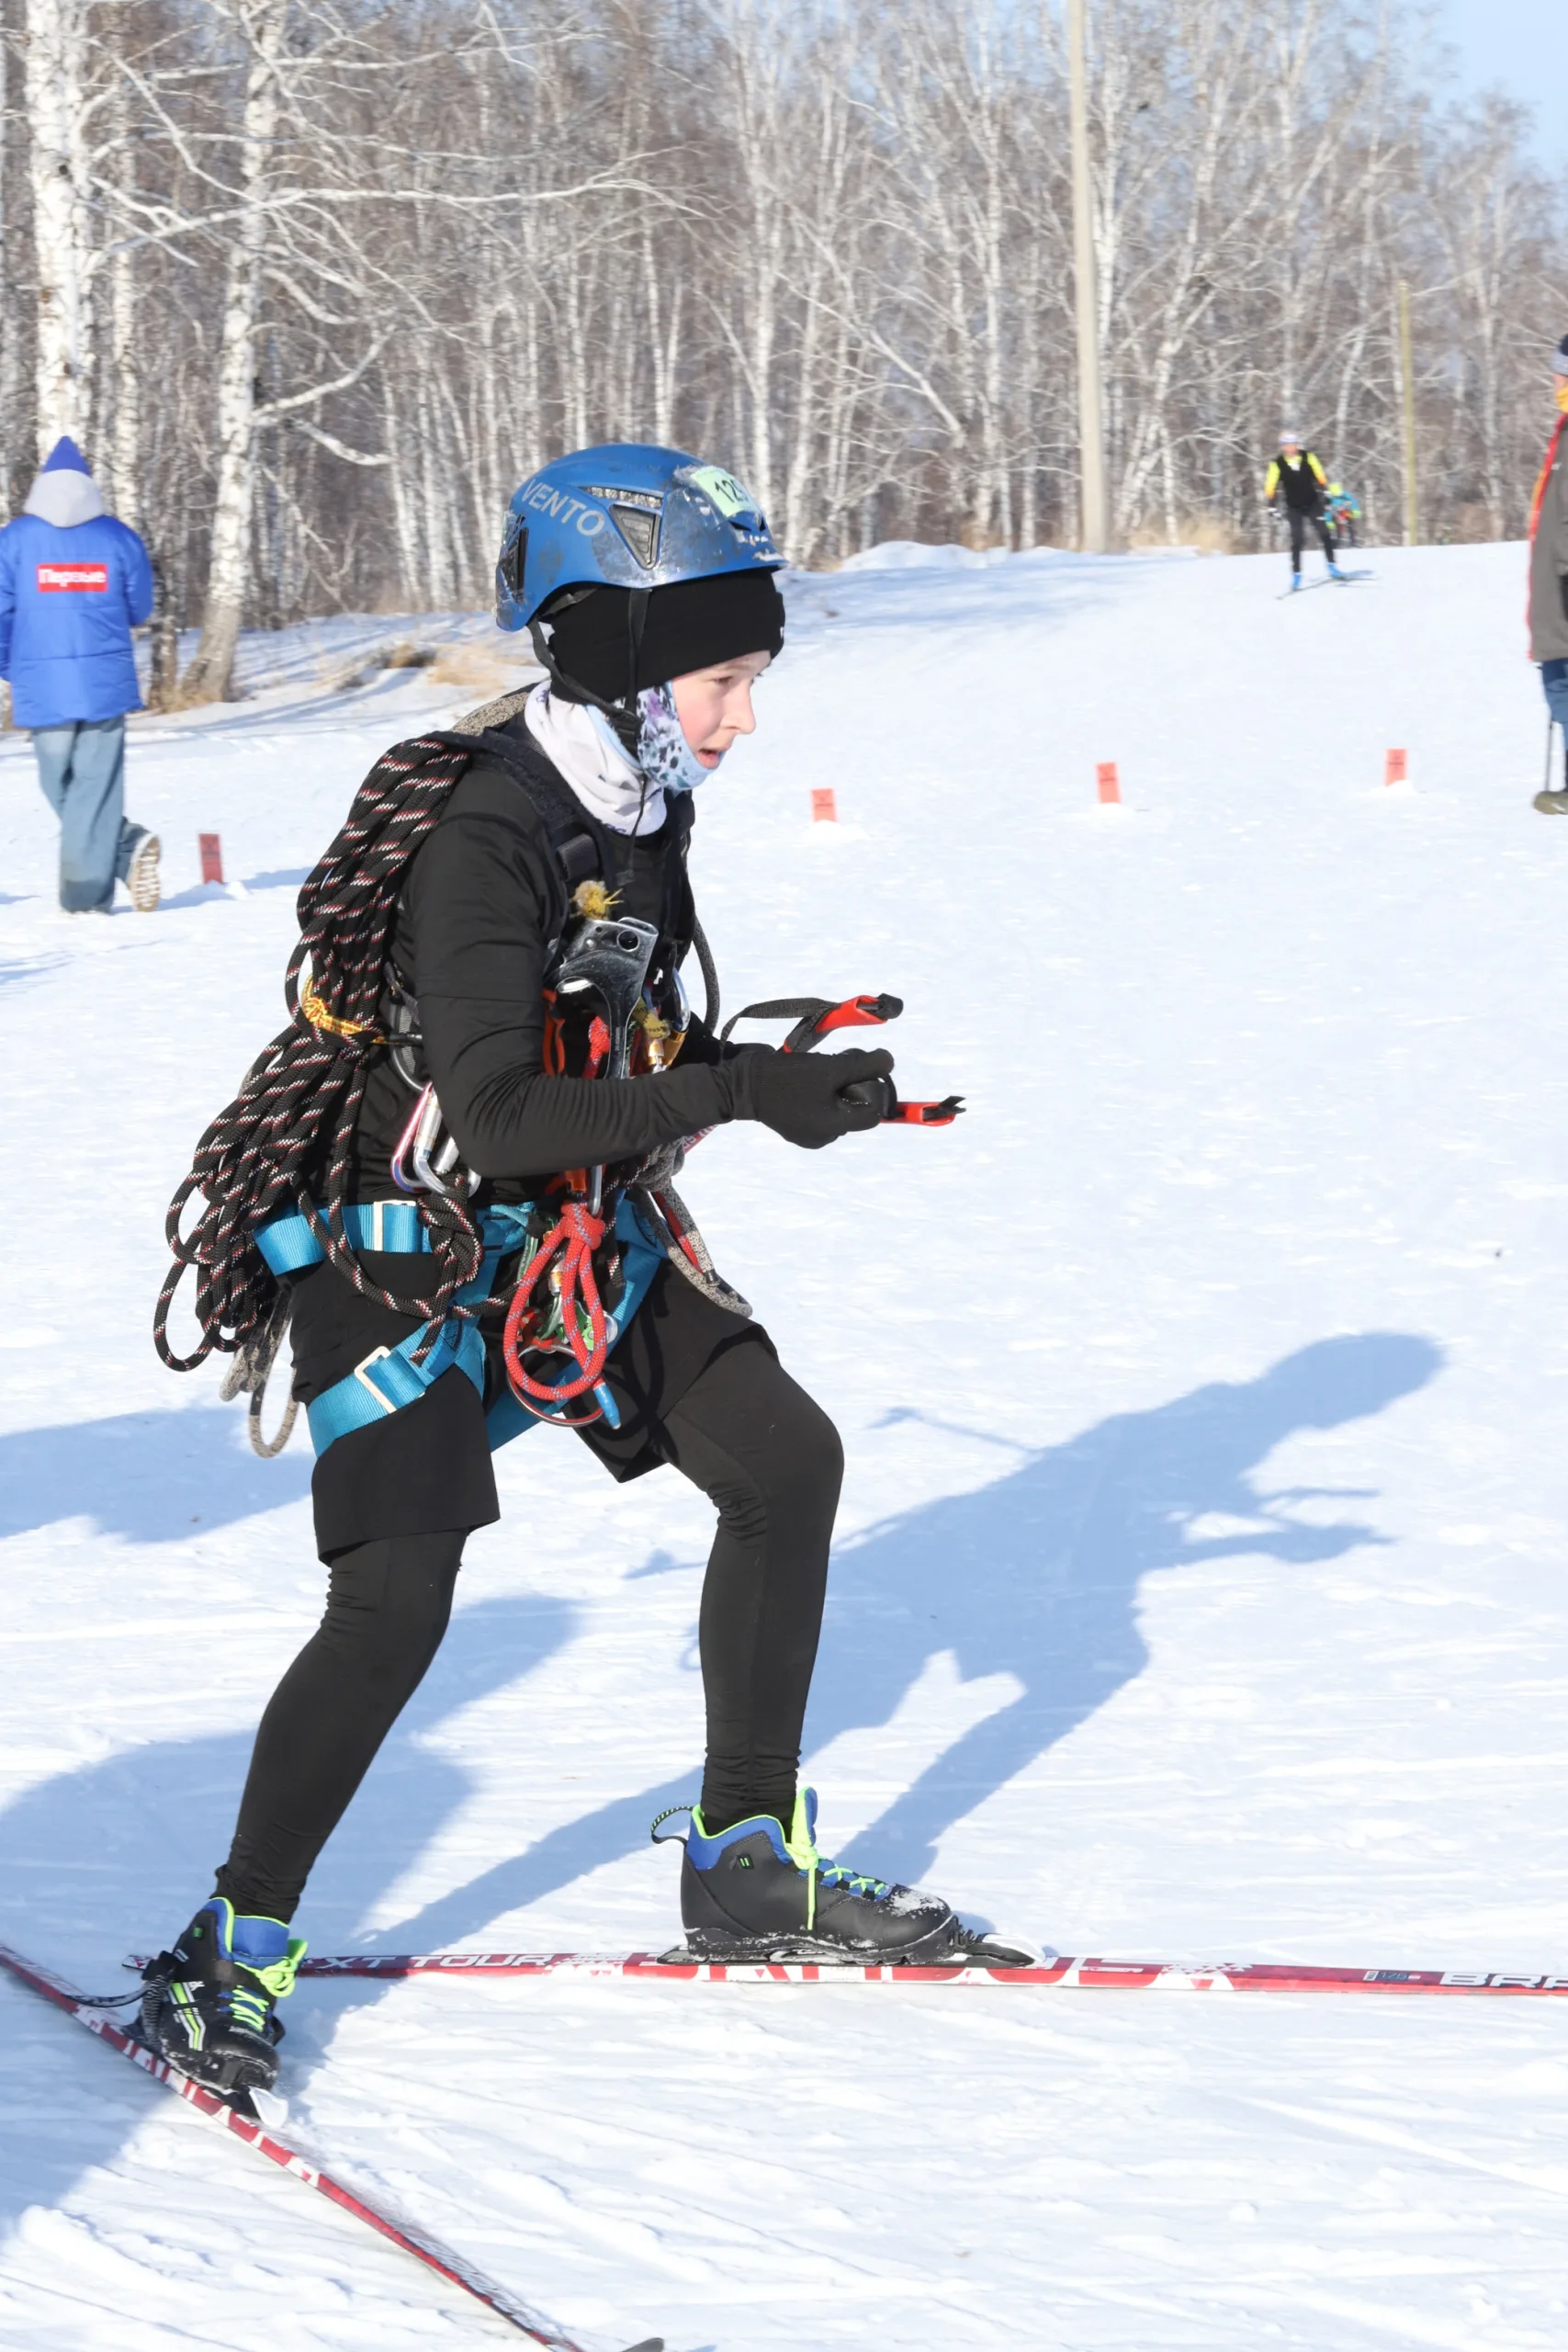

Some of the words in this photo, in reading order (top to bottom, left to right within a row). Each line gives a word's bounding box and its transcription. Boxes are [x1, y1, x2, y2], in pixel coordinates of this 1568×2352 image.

[521, 478, 605, 537] VENTO
[38, 568, 107, 588] Первые
[409, 1953, 555, 1969] TOUR
